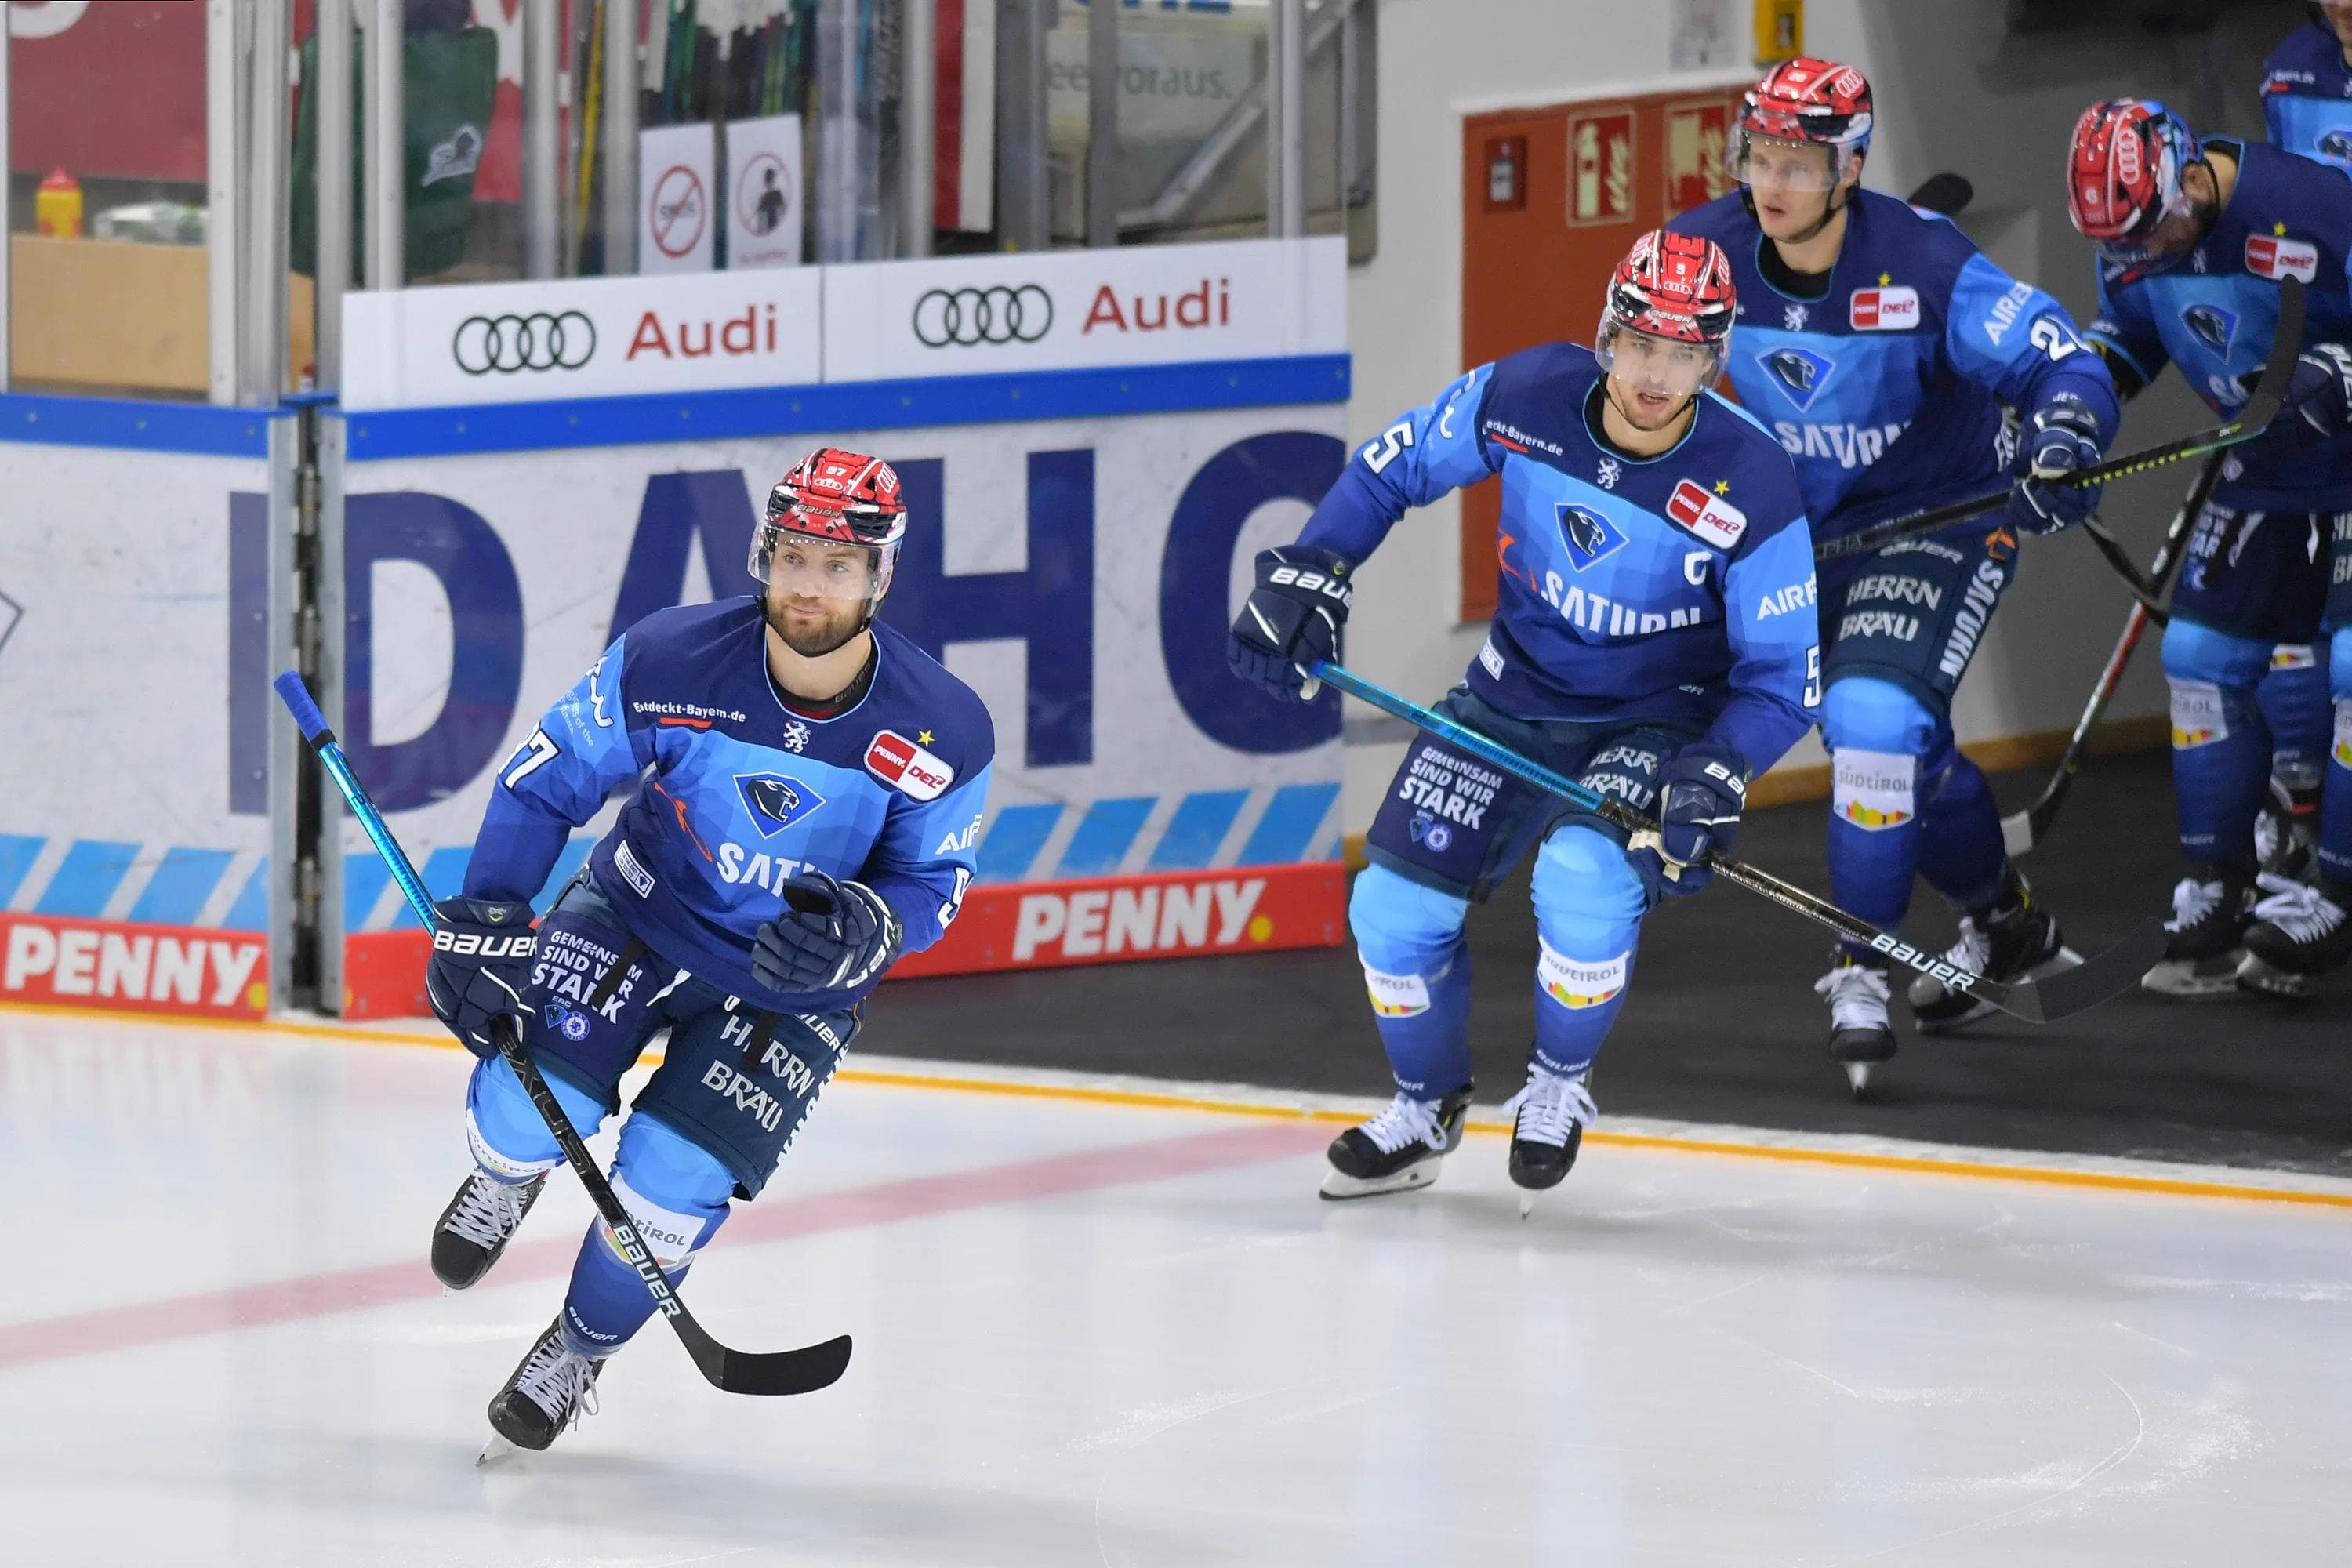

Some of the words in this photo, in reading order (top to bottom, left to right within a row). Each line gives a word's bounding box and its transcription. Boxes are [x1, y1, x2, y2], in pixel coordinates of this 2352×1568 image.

[1082, 278, 1231, 335] Audi
[626, 304, 778, 361] Audi
[2030, 315, 2093, 362] 2
[1362, 420, 1414, 475] 5
[1485, 419, 1564, 457] eckt-Bayern.de
[1683, 550, 1713, 586] C
[1846, 574, 1942, 612] HERRN
[1409, 757, 1454, 787] SIND
[1454, 775, 1495, 807] WIR
[1421, 746, 1504, 790] GEMEINSAM
[1588, 745, 1658, 776] ERR
[1399, 775, 1487, 831] STARK
[716, 841, 815, 898] SAT
[540, 944, 590, 972] SIND
[550, 930, 644, 982] GEMEINSM
[719, 1014, 816, 1099] HRRN
[700, 1058, 784, 1133] BRÄU
